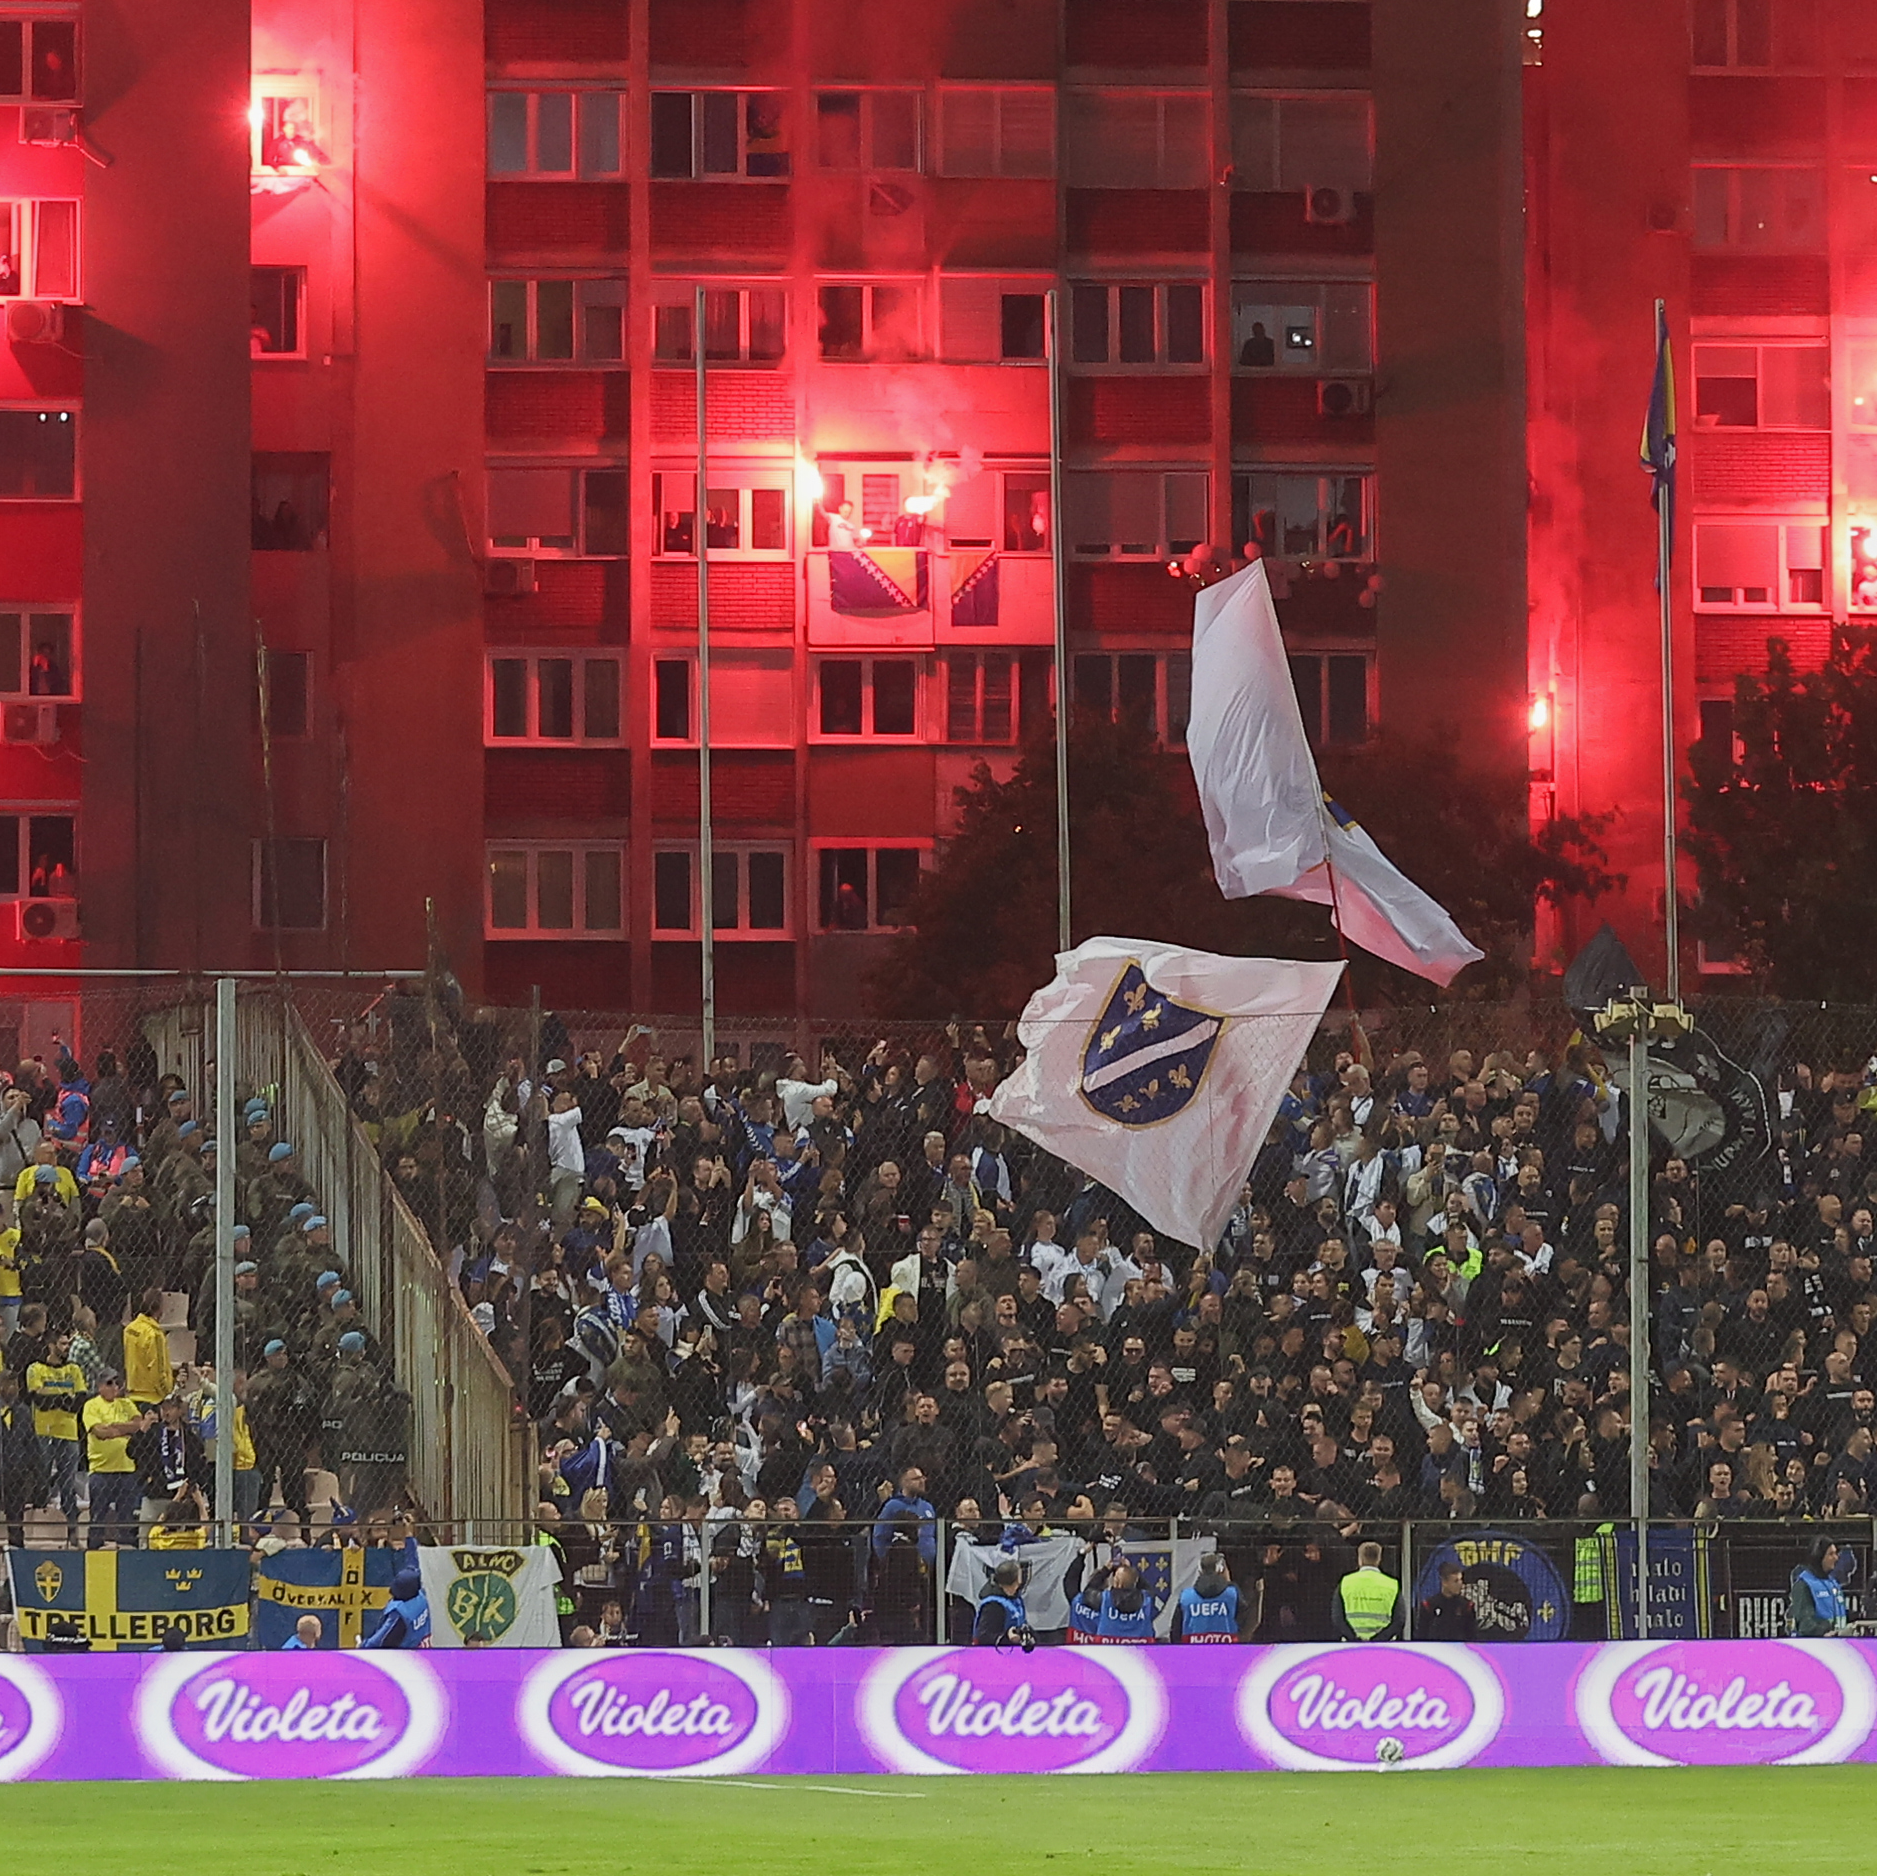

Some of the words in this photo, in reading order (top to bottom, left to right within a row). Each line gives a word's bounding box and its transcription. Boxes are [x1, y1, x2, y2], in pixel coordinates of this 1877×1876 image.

[1189, 1603, 1228, 1617] UEFA
[196, 1678, 383, 1741] Violeta
[570, 1680, 735, 1736] Violeta
[919, 1673, 1104, 1737] Violeta
[1289, 1674, 1451, 1730] Violeta
[1634, 1665, 1821, 1731] Violeta
